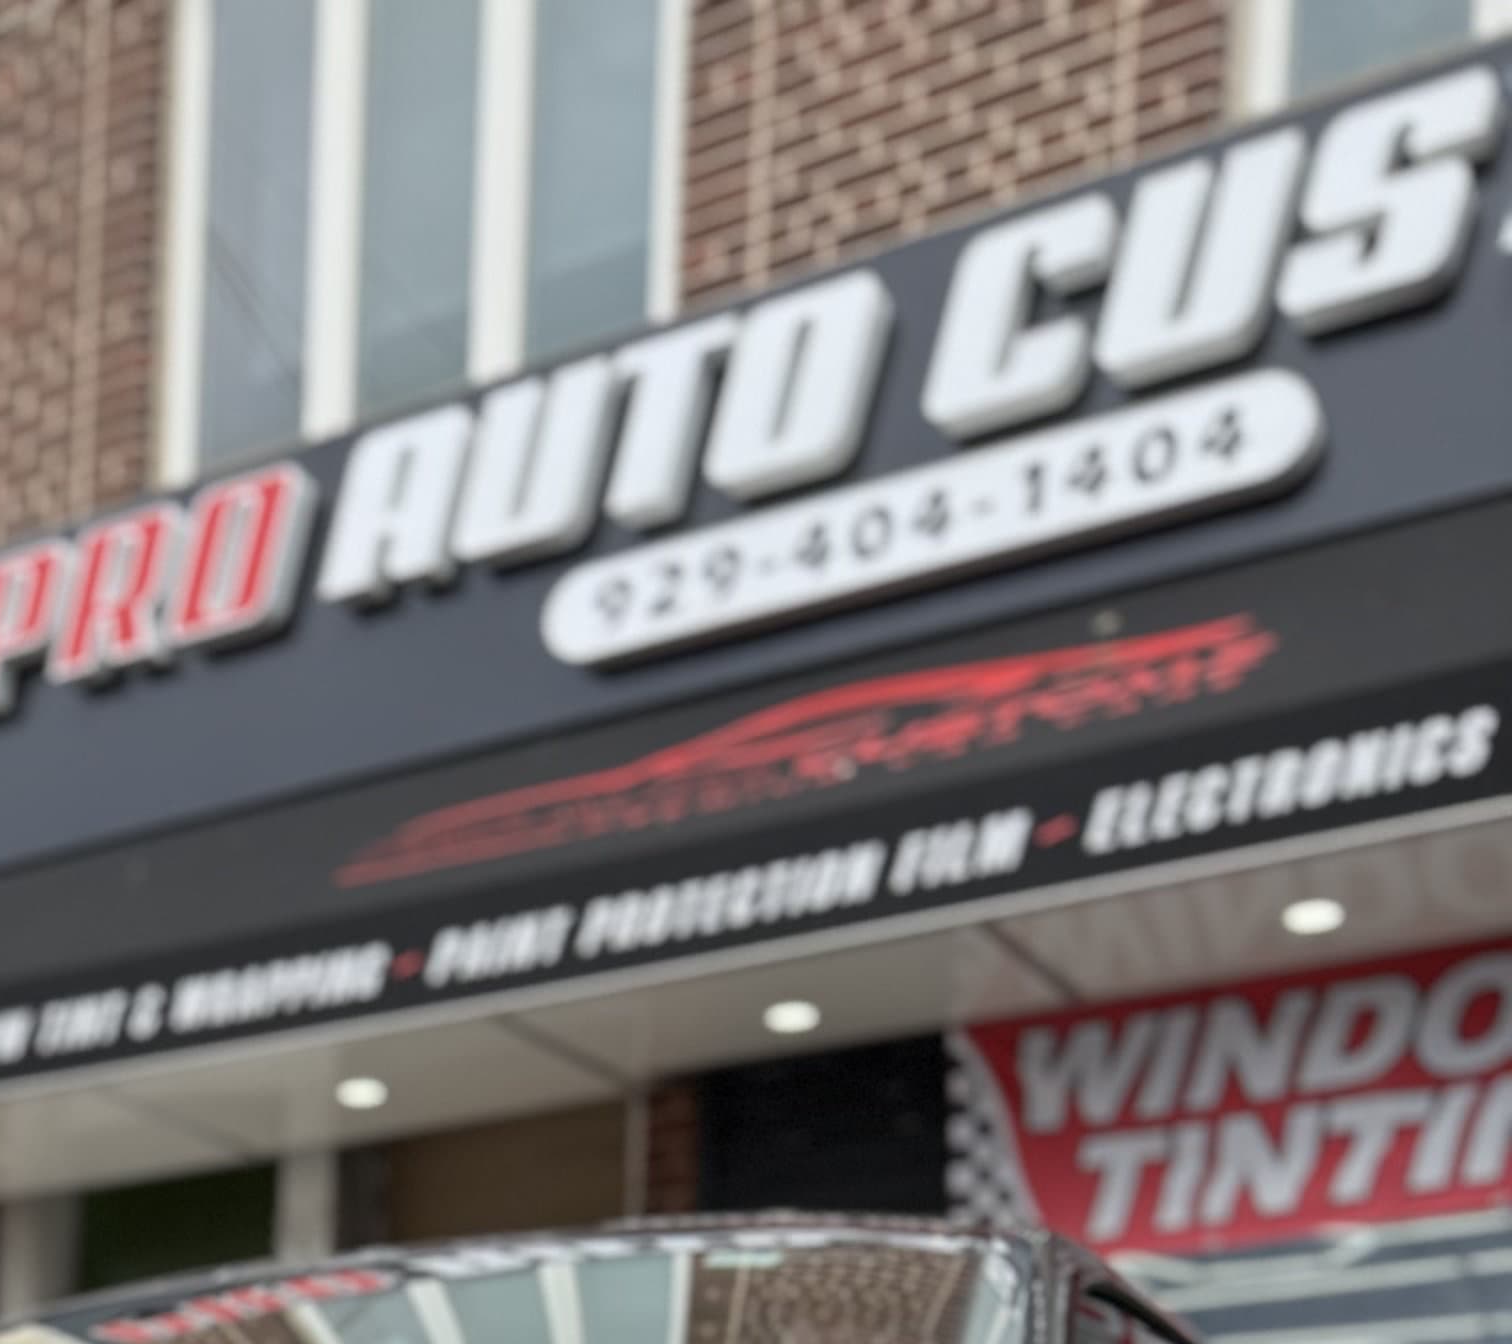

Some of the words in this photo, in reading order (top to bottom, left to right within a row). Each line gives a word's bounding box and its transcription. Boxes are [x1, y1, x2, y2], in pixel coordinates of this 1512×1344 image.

[317, 266, 891, 603] AUTO
[920, 62, 1512, 444] CUS
[594, 408, 1248, 633] 929-404-1404
[168, 939, 393, 1035] WRAPPING
[422, 903, 575, 990] PAINT
[573, 837, 888, 960] PROTECTION
[888, 805, 1035, 897] FILM
[1081, 703, 1500, 857] ELECTRONICS
